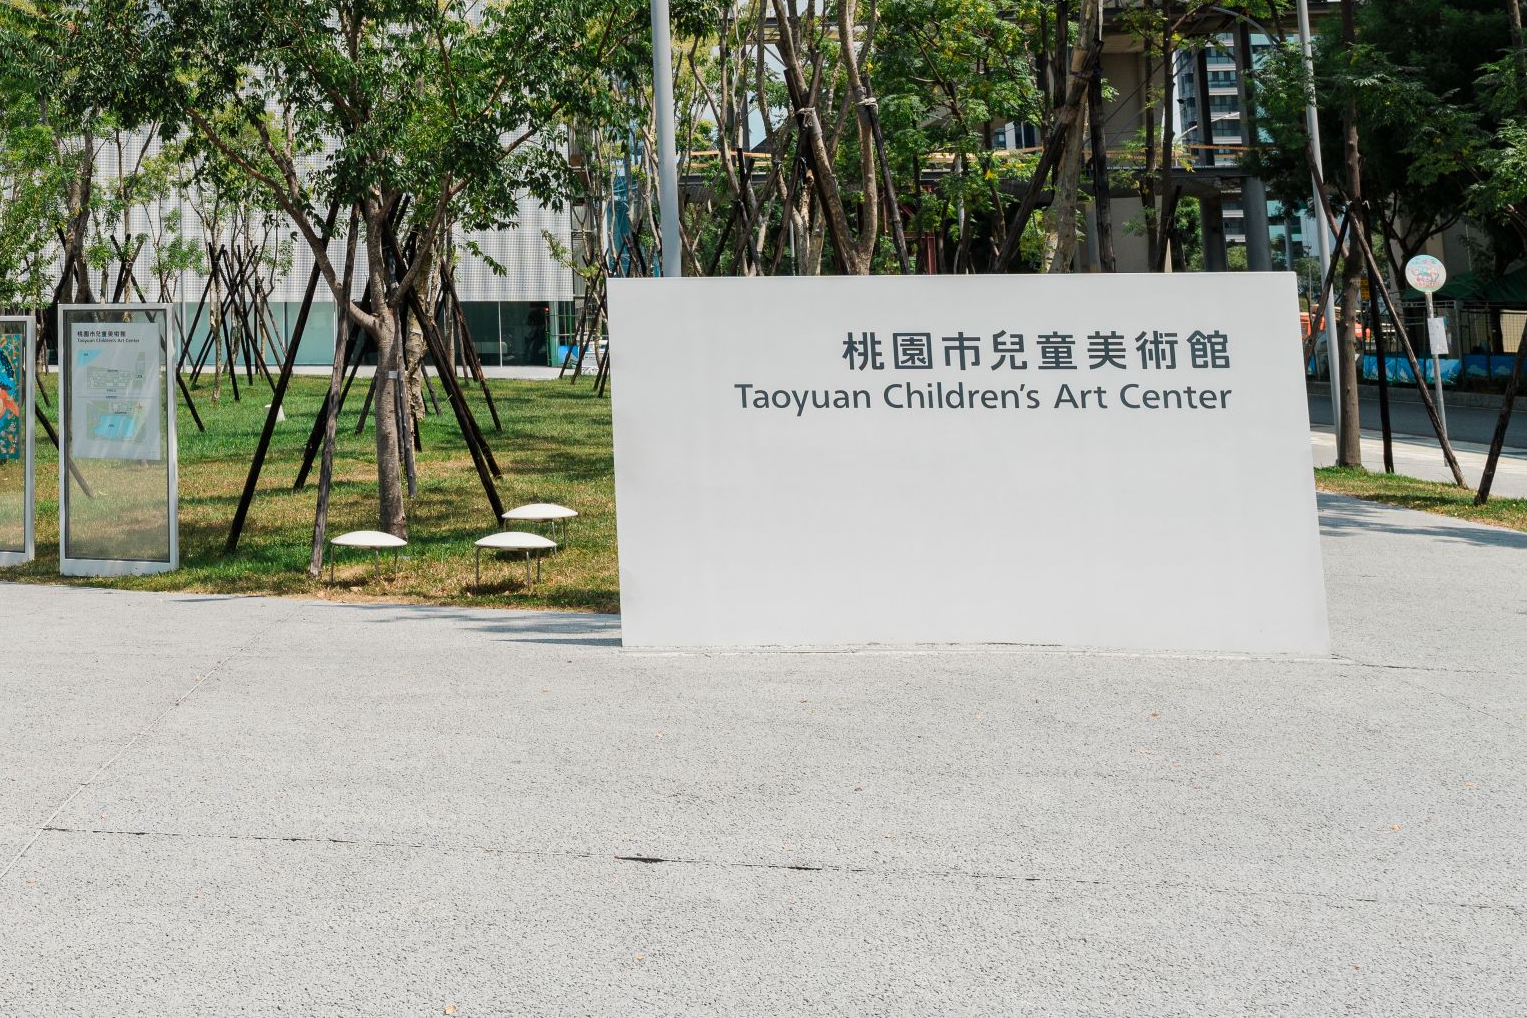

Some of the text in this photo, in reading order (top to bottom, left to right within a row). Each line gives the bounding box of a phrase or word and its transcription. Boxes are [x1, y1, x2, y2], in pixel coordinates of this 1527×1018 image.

[842, 330, 1231, 371] 桃園市兒童美術館
[734, 382, 1233, 417] Taoyuan Children's Art Center
